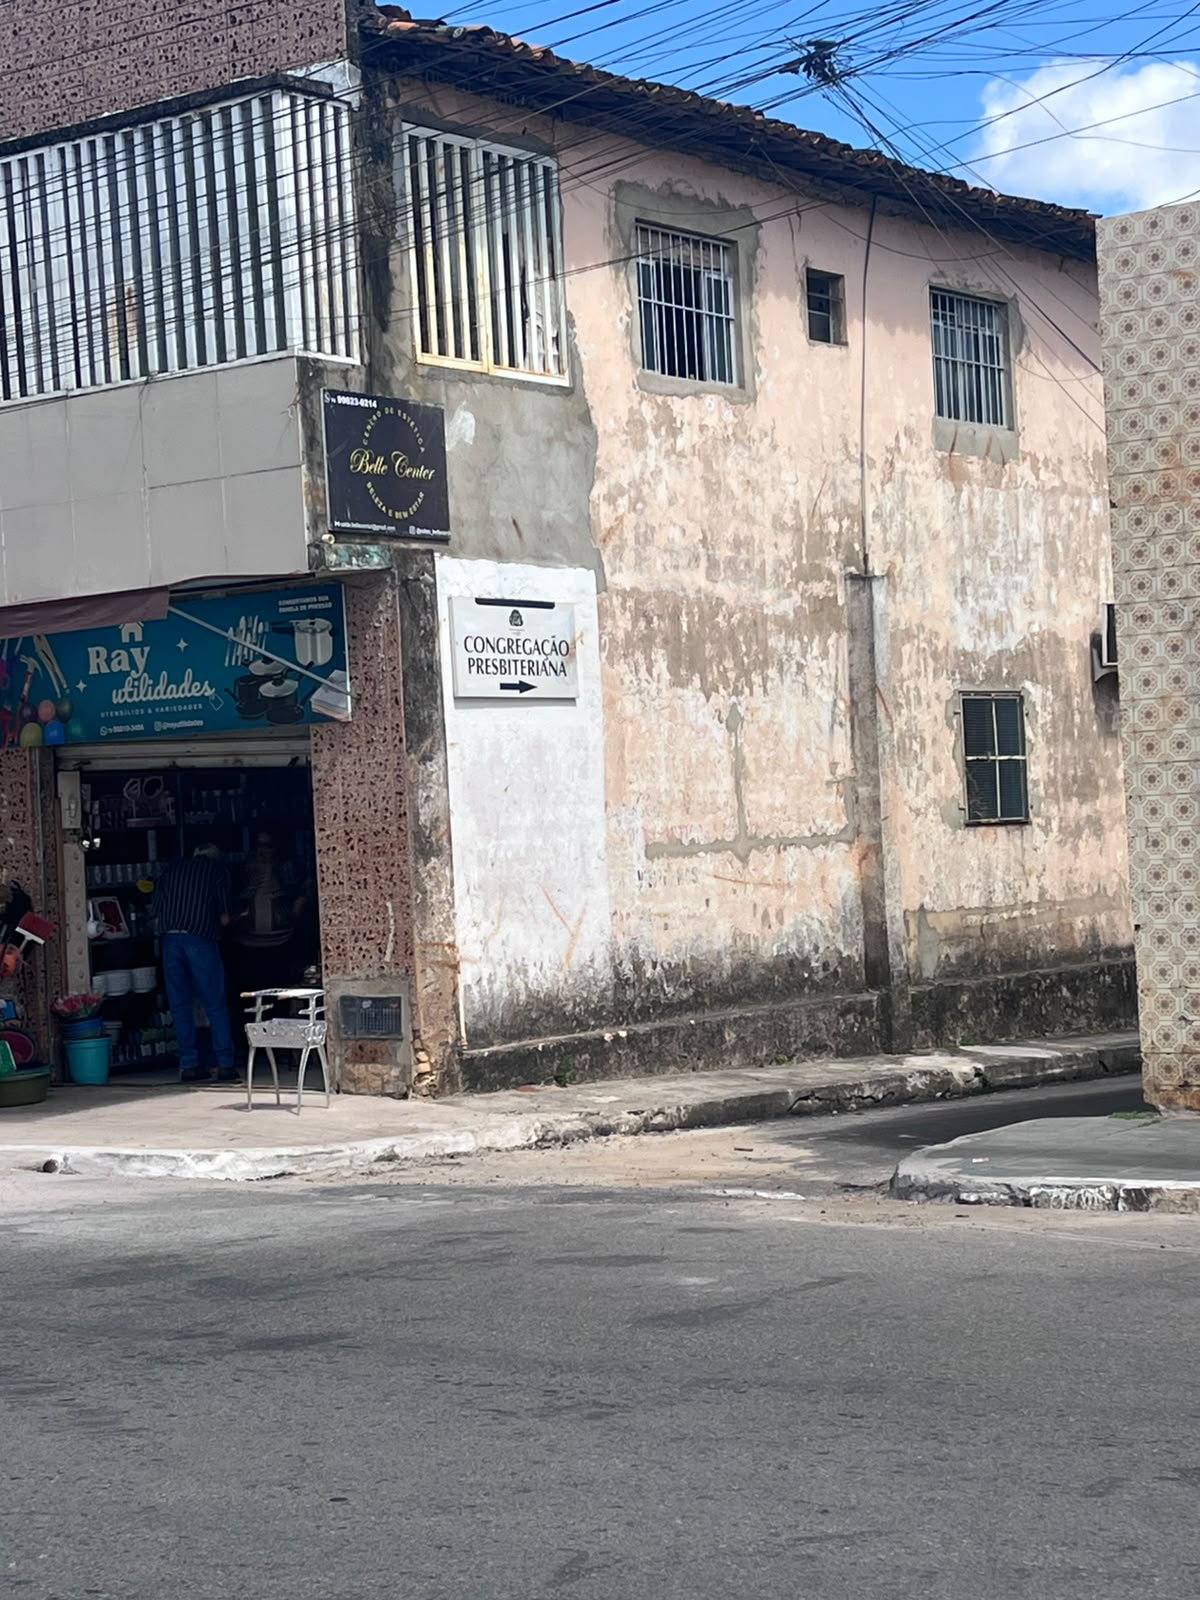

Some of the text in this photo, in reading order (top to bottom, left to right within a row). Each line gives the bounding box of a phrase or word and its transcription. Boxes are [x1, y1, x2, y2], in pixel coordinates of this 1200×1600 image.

[363, 410, 382, 446] CENTRO
[350, 448, 436, 480] Belle Center
[366, 481, 387, 514] BELEZA
[87, 645, 151, 679] Ray
[463, 634, 570, 661] CONGREGAÇÃO
[467, 657, 568, 678] PRESBITERIANA
[111, 668, 216, 704] utilidades
[155, 703, 203, 714] VARIEDADES
